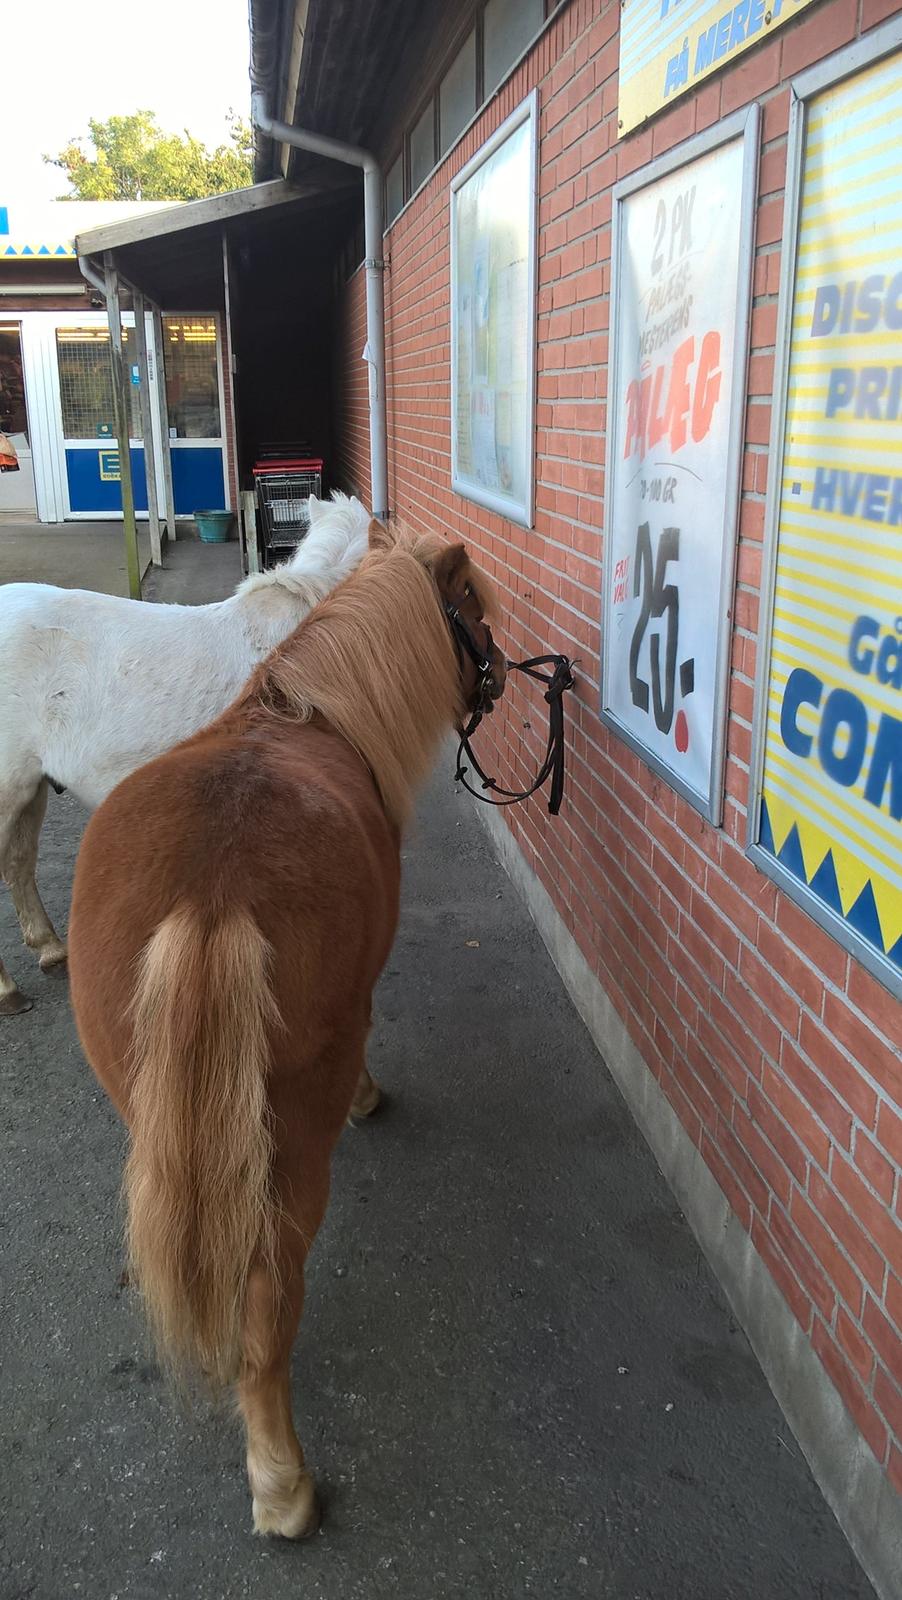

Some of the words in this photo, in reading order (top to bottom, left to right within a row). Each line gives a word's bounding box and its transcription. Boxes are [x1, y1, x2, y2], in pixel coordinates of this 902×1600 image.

[664, 36, 689, 98] FÅ
[651, 198, 667, 278] 2
[623, 331, 722, 463] PÅLÆG
[662, 476, 678, 504] GR
